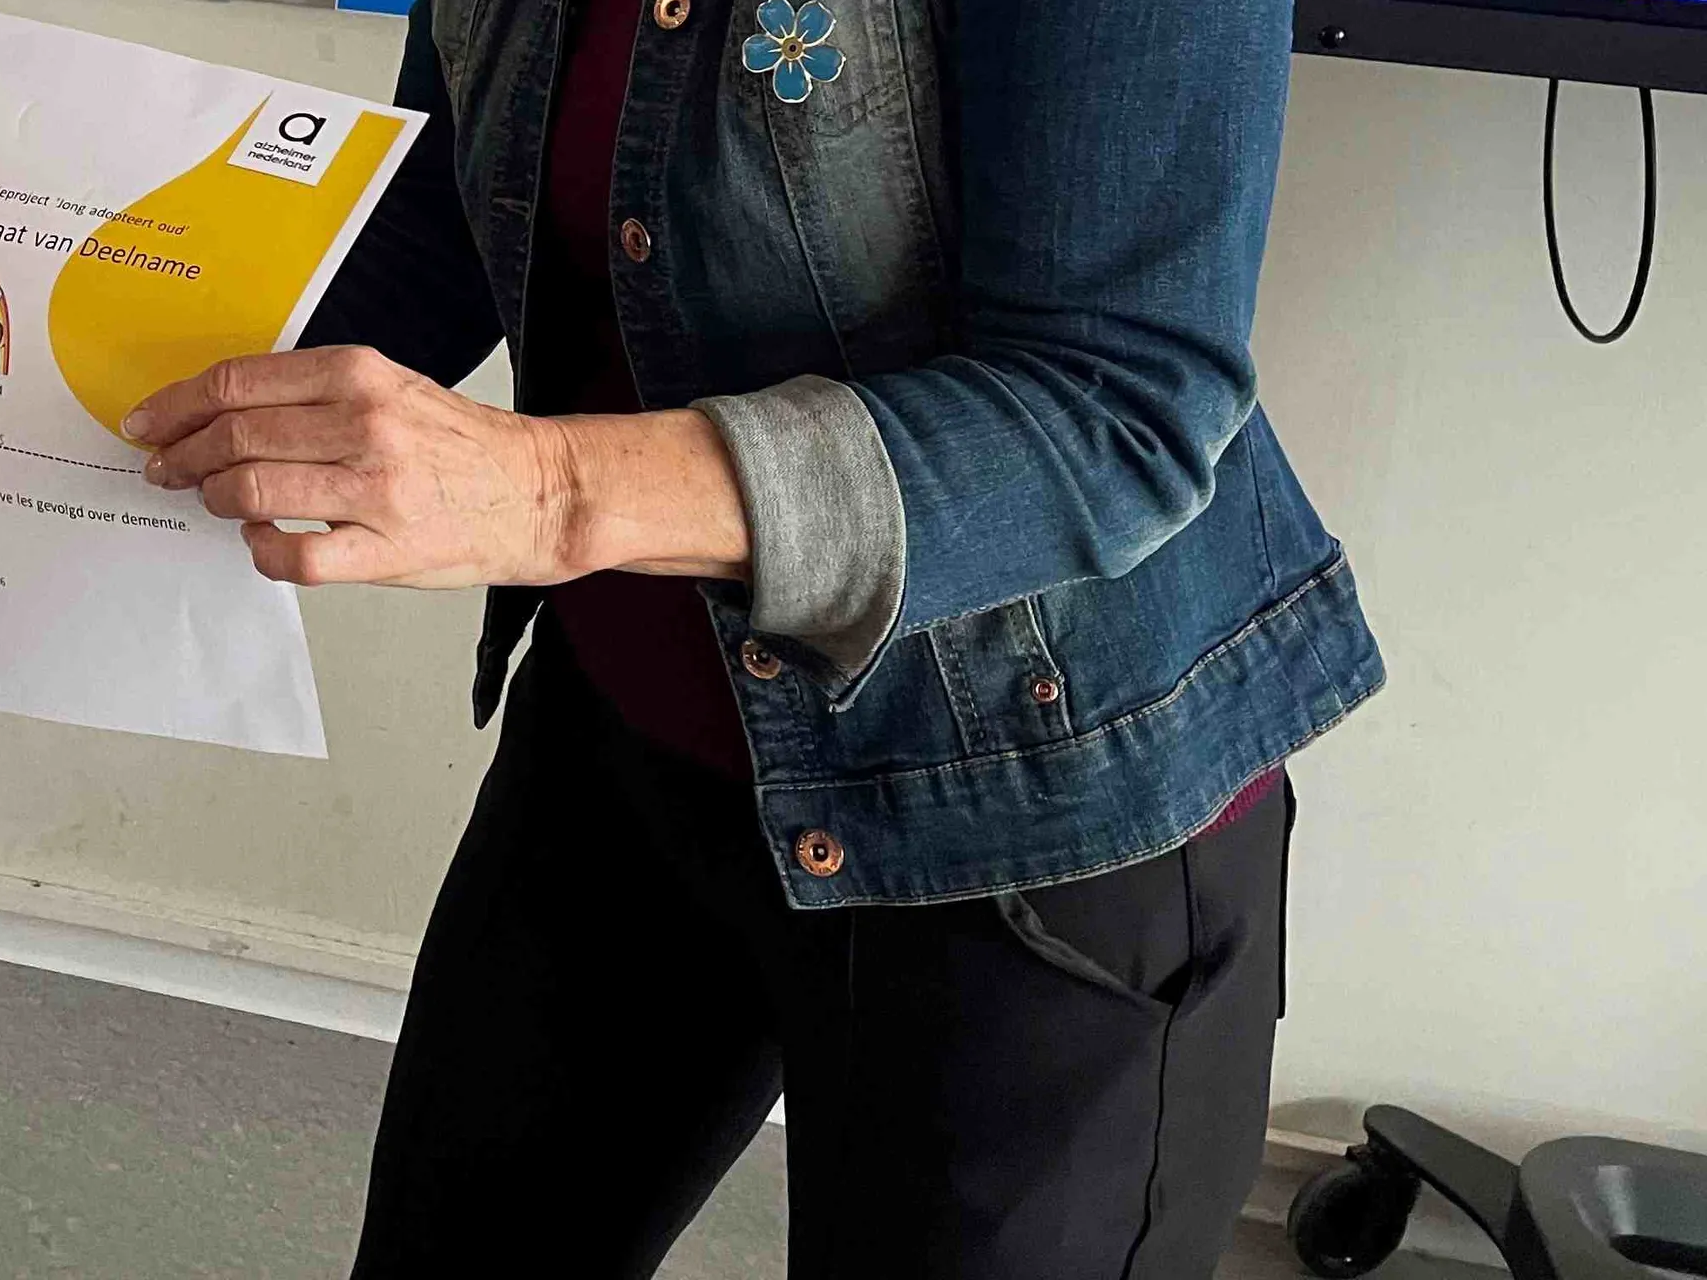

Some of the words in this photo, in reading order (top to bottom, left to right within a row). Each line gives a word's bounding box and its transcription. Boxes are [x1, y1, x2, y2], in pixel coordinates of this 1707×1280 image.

[279, 113, 327, 146] a
[247, 150, 312, 172] nederland
[254, 141, 316, 162] alzheimer
[89, 205, 153, 229] adopteert
[34, 230, 74, 252] van
[79, 236, 202, 281] Deelname
[16, 493, 34, 508] les
[36, 500, 84, 520] gevolgd
[87, 509, 116, 522] over
[121, 511, 191, 532] dementie.
